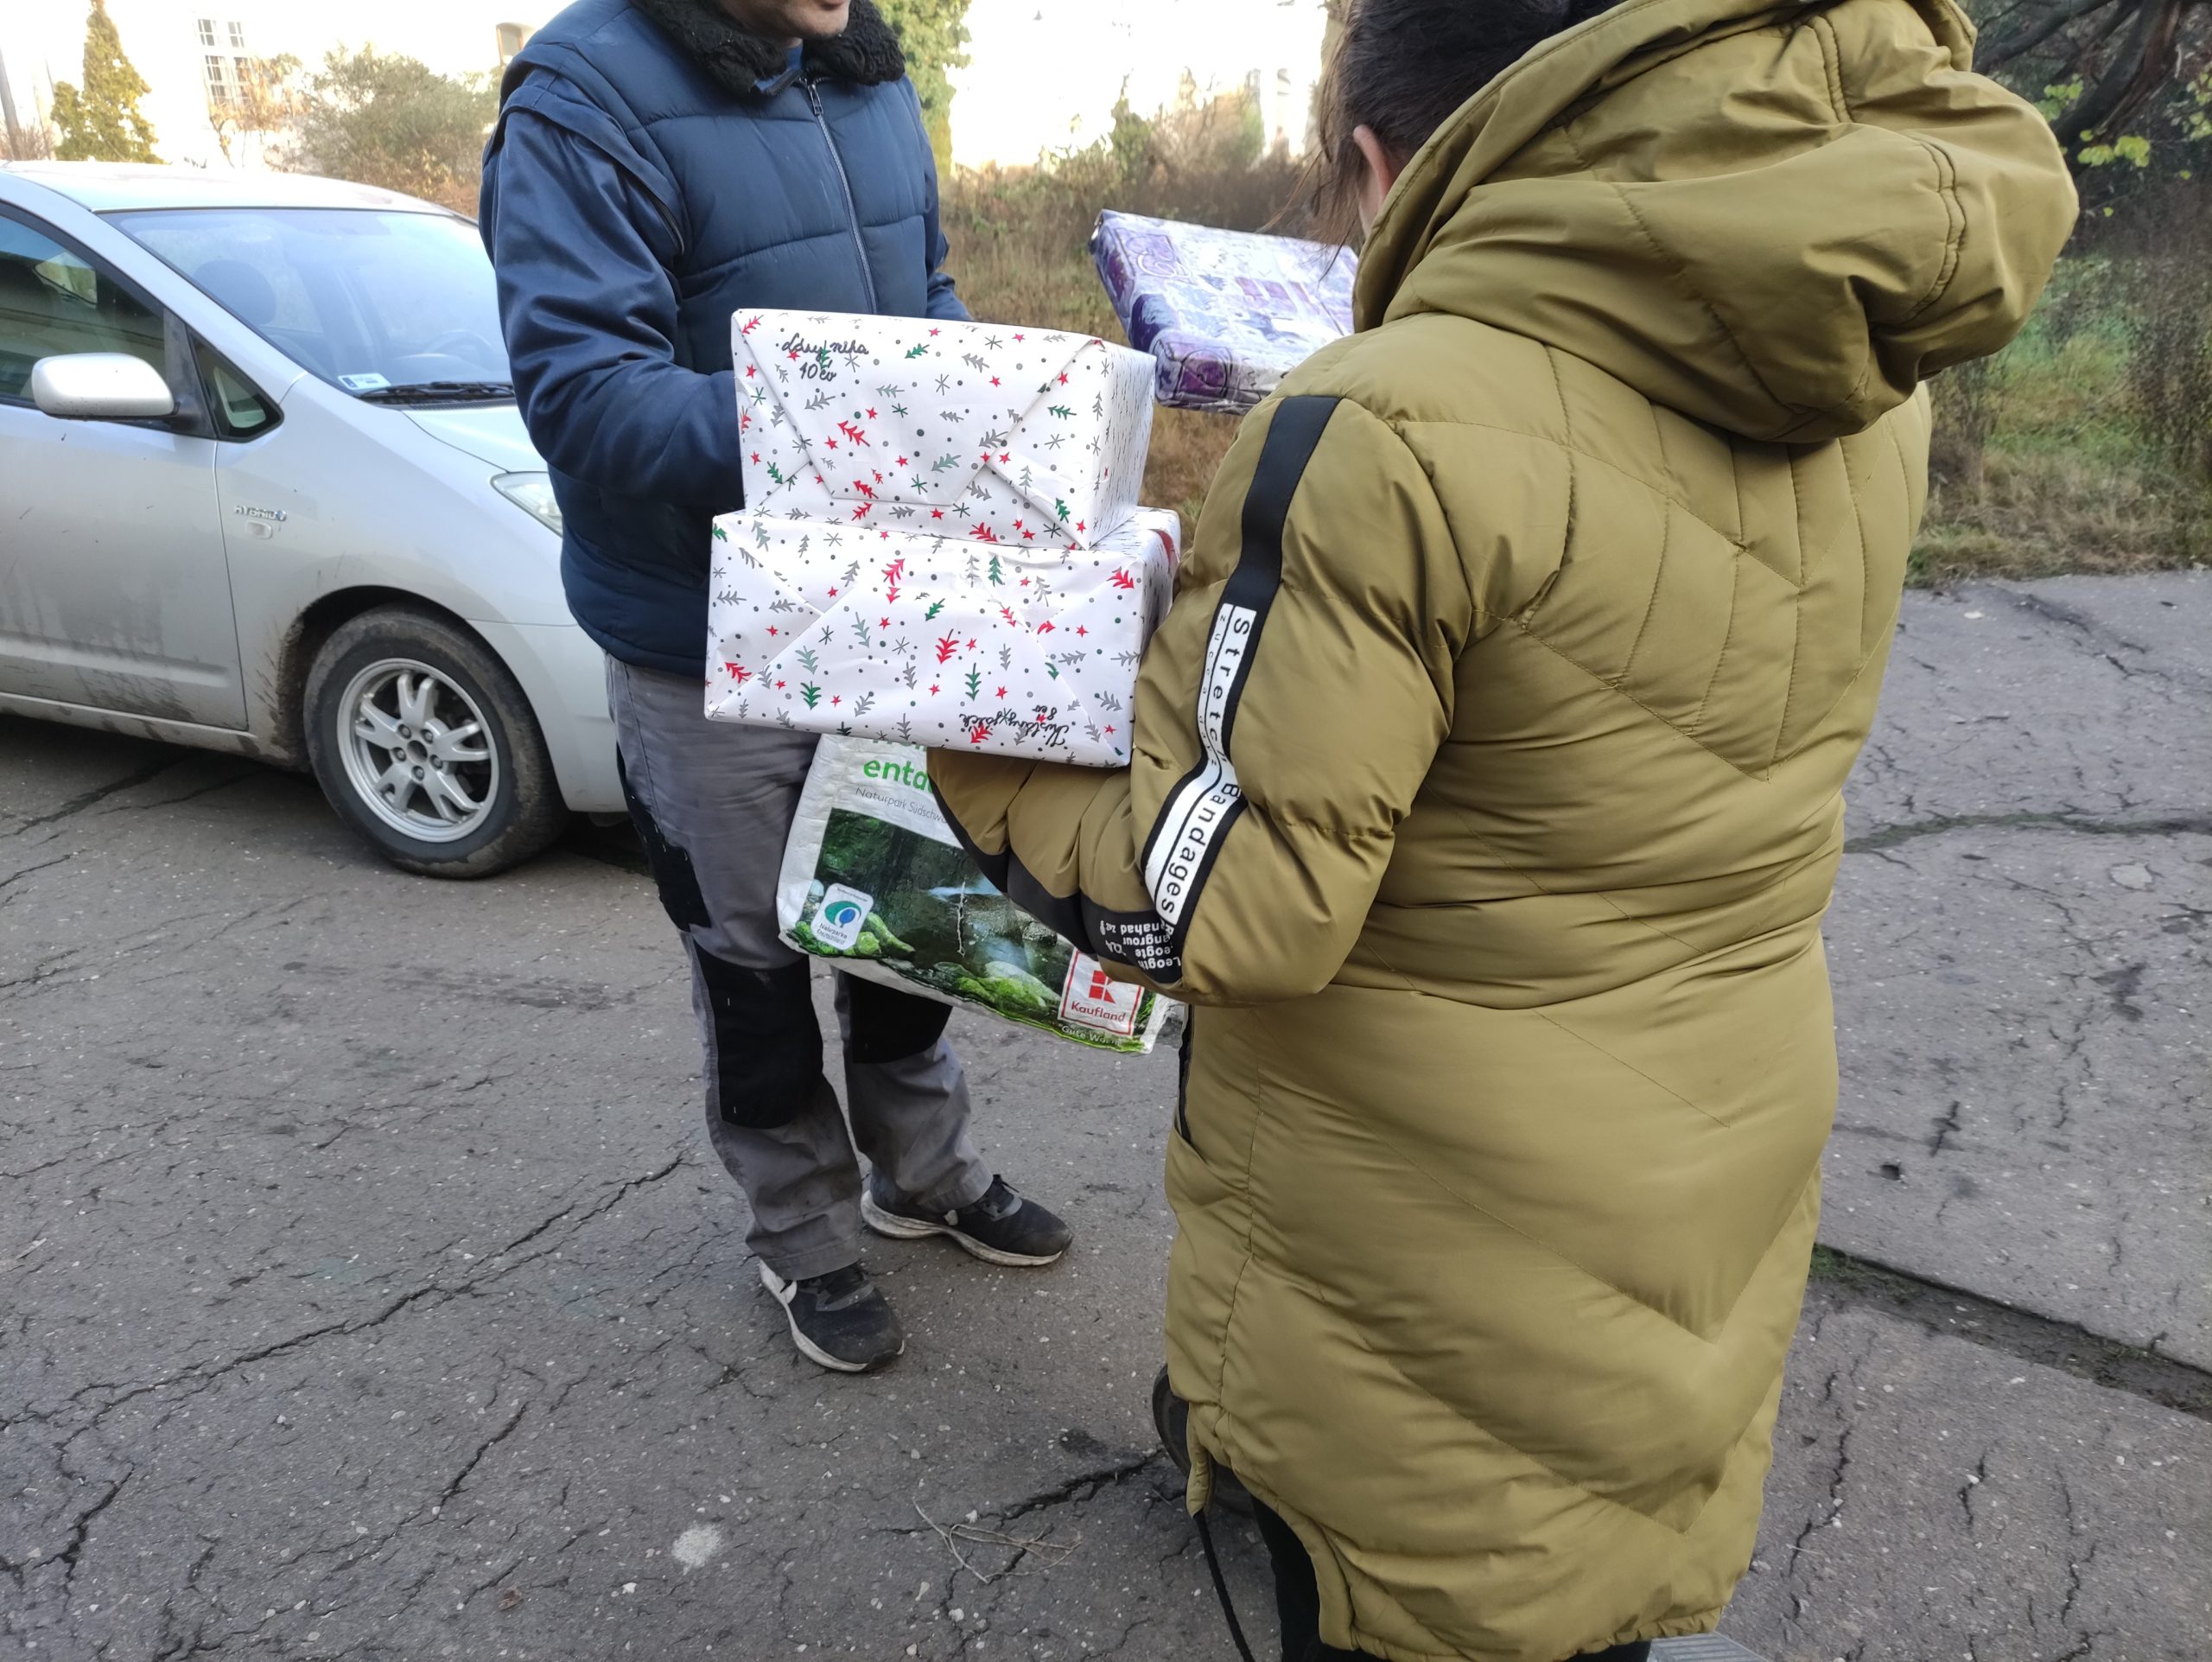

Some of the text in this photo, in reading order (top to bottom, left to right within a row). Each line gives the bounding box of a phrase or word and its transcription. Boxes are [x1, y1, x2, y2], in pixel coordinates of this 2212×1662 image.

[798, 361, 818, 379] 10
[855, 787, 907, 809] Naturpark
[1161, 783, 1241, 914] Bandages
[1071, 1001, 1127, 1022] Kaufland
